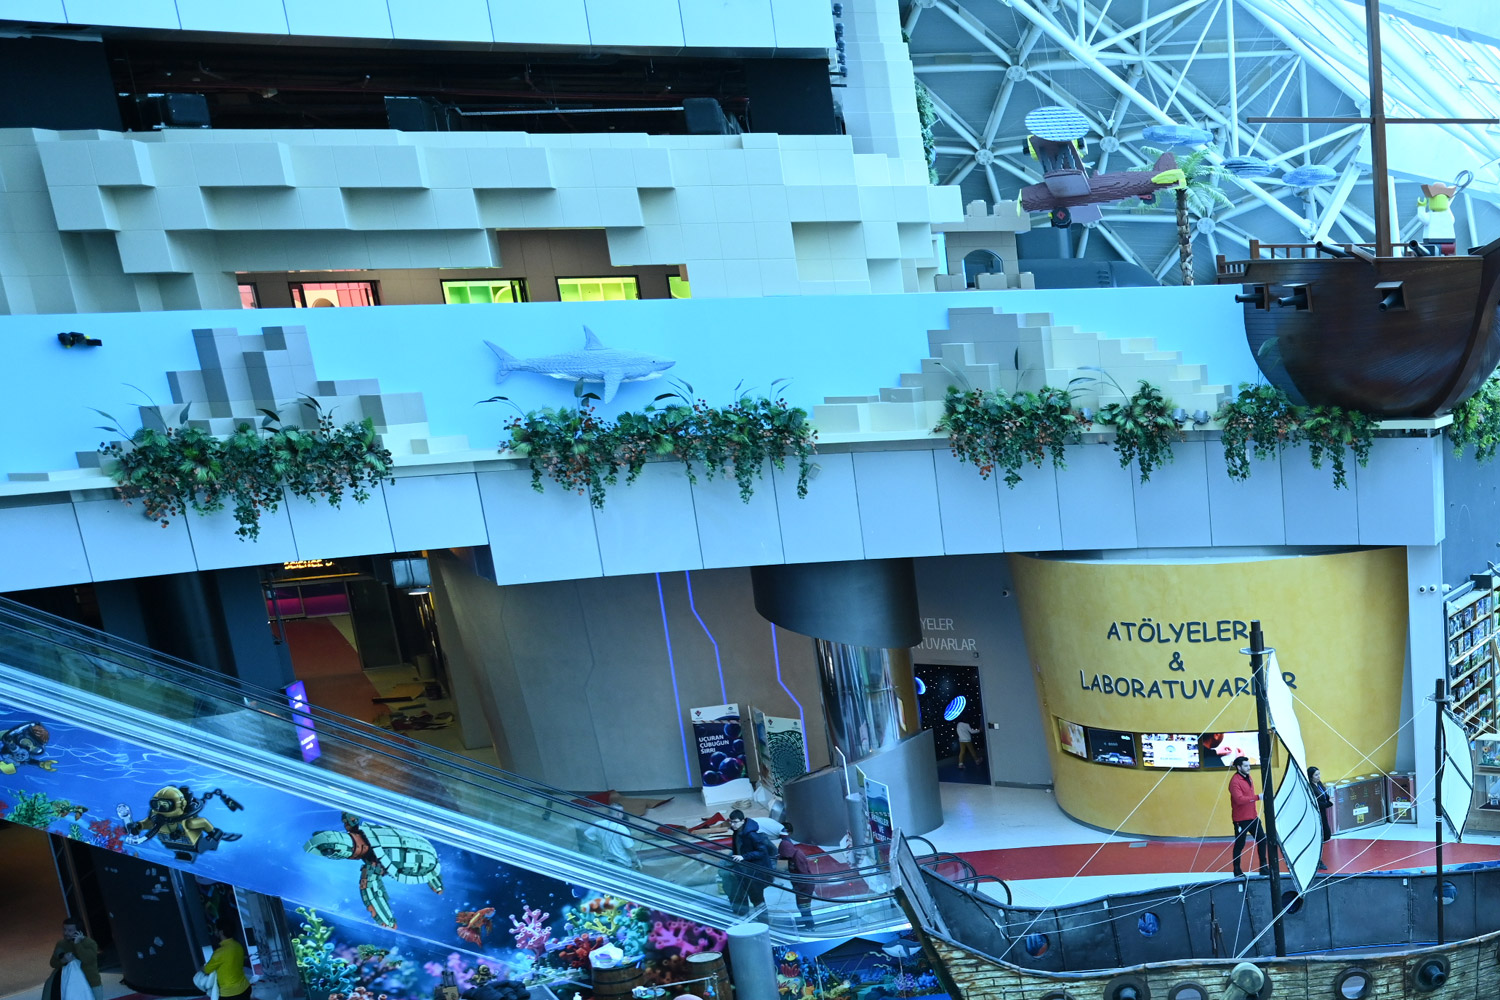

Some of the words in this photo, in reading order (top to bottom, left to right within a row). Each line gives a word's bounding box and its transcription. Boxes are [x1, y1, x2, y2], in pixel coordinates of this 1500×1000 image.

[919, 617, 955, 631] YELER
[1107, 618, 1249, 644] ATÖLYELER
[918, 637, 977, 651] TUVARLAR
[1168, 651, 1185, 672] &
[1079, 669, 1298, 700] LABORATUVARLR
